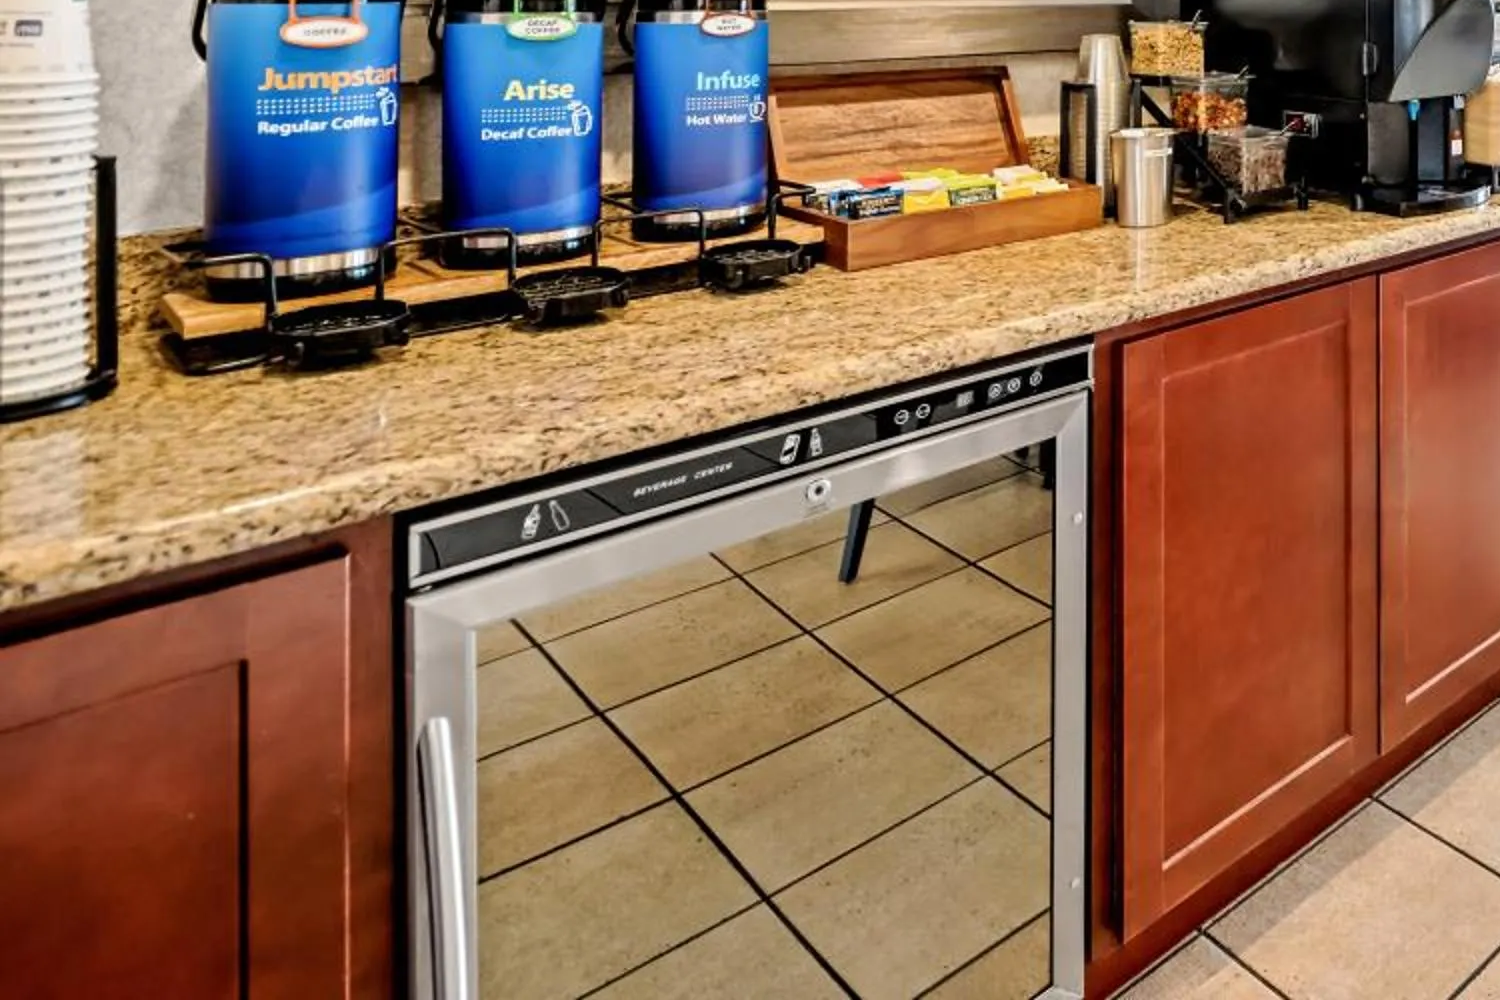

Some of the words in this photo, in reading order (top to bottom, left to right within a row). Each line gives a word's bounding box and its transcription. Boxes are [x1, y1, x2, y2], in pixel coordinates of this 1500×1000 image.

[503, 79, 575, 101] Arise
[696, 70, 760, 91] Infuse
[257, 119, 328, 137] Regular
[331, 114, 379, 131] Coffee
[686, 114, 711, 127] Hot
[713, 113, 748, 126] Water
[481, 127, 525, 141] Decaf
[527, 125, 573, 139] Coffee
[633, 475, 688, 498] BEVERAGE
[693, 462, 733, 480] CENTER
